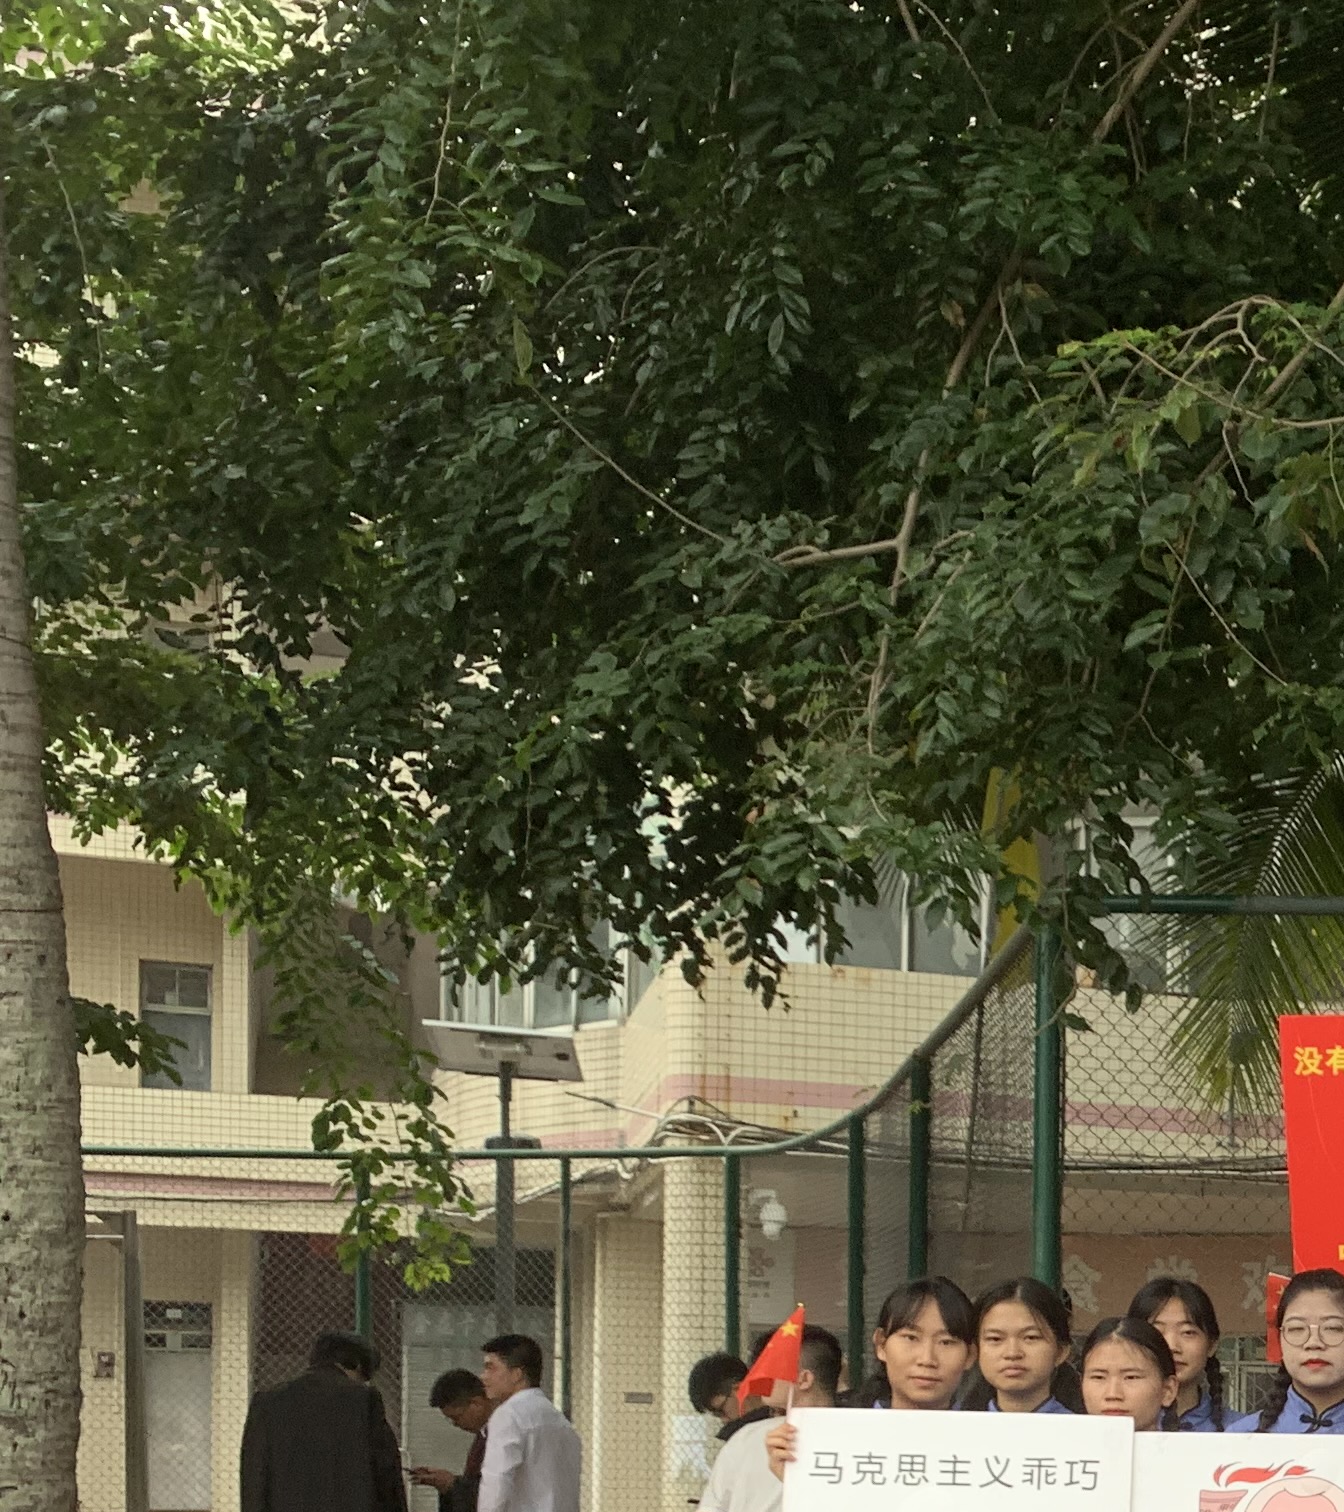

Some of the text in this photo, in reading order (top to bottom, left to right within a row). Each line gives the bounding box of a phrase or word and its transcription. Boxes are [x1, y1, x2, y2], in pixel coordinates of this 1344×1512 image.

[808, 1451, 1101, 1491] 马克思主义乖巧
